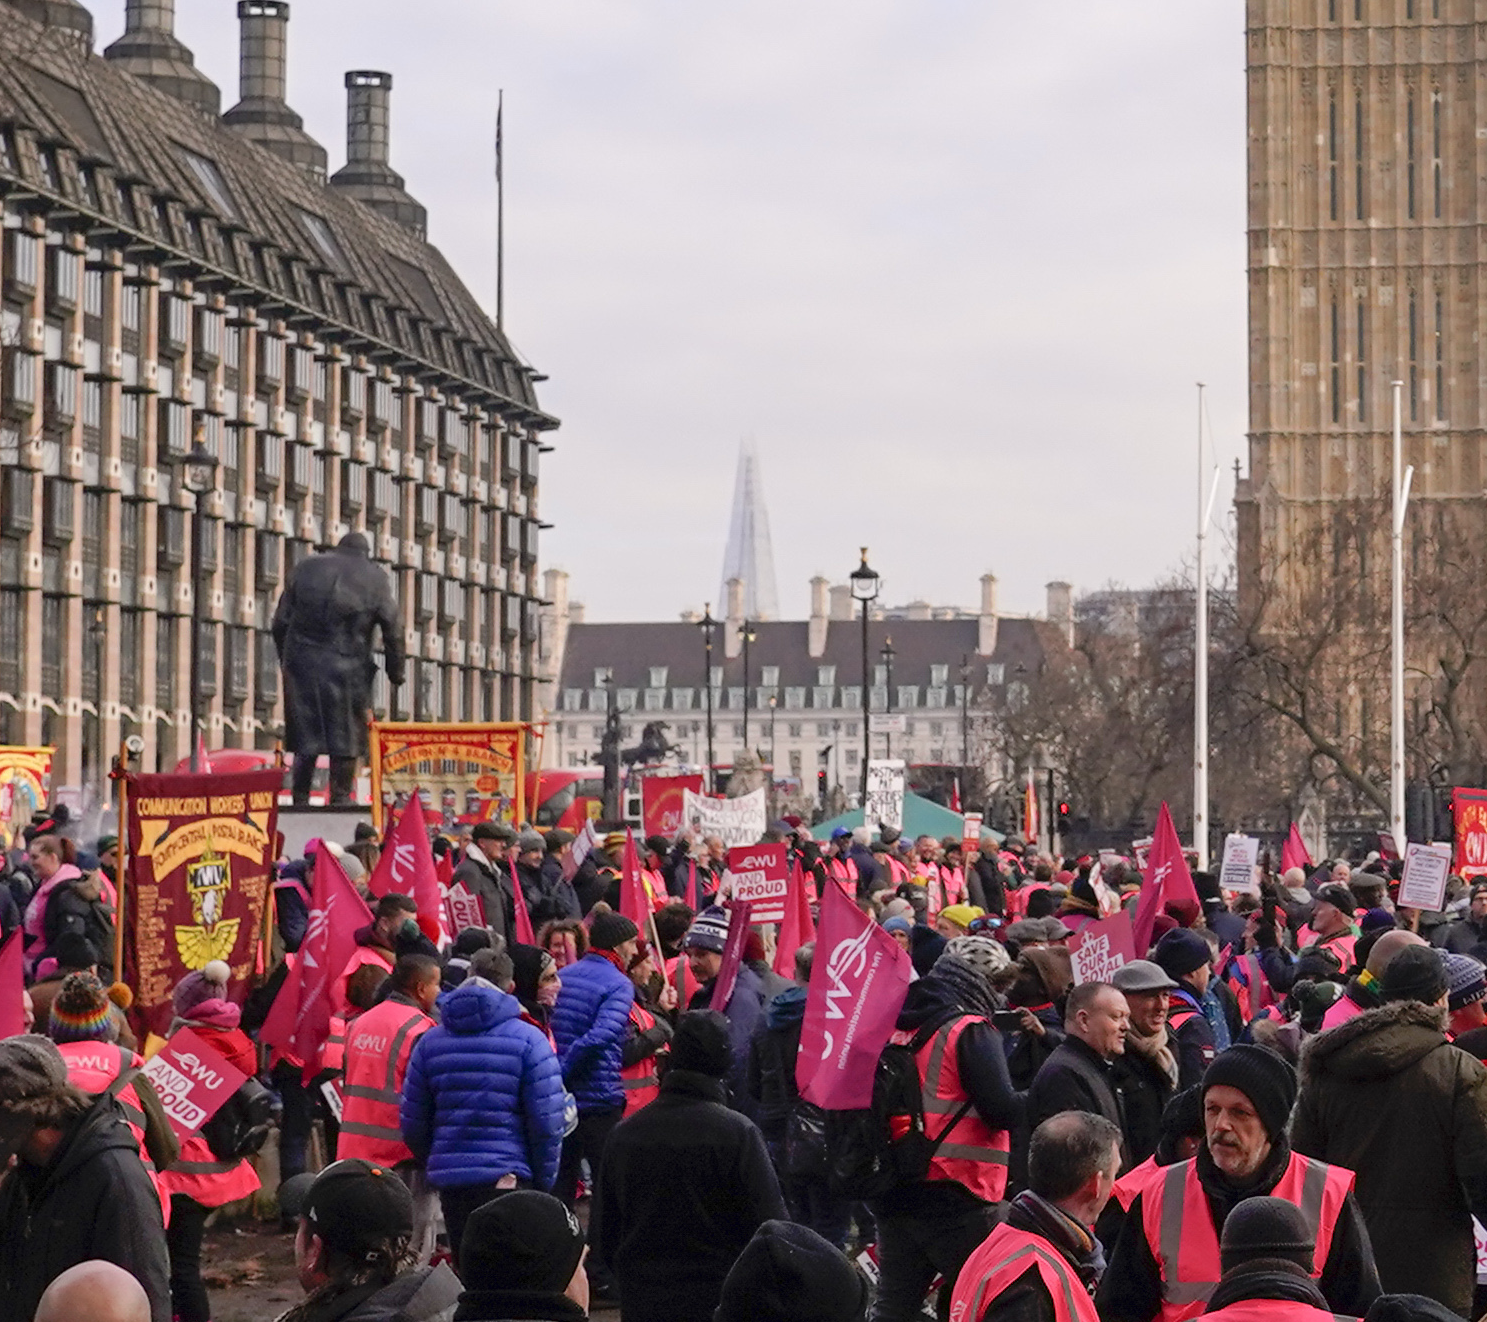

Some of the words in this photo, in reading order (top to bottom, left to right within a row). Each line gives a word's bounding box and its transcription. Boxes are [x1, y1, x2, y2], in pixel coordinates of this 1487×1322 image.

[735, 853, 777, 870] CWU
[735, 872, 764, 887] AND
[738, 882, 784, 897] PROUD
[1077, 937, 1106, 964] SAVE
[1080, 953, 1104, 976] OUR
[149, 1063, 188, 1096] AND
[170, 1049, 224, 1090] CWU
